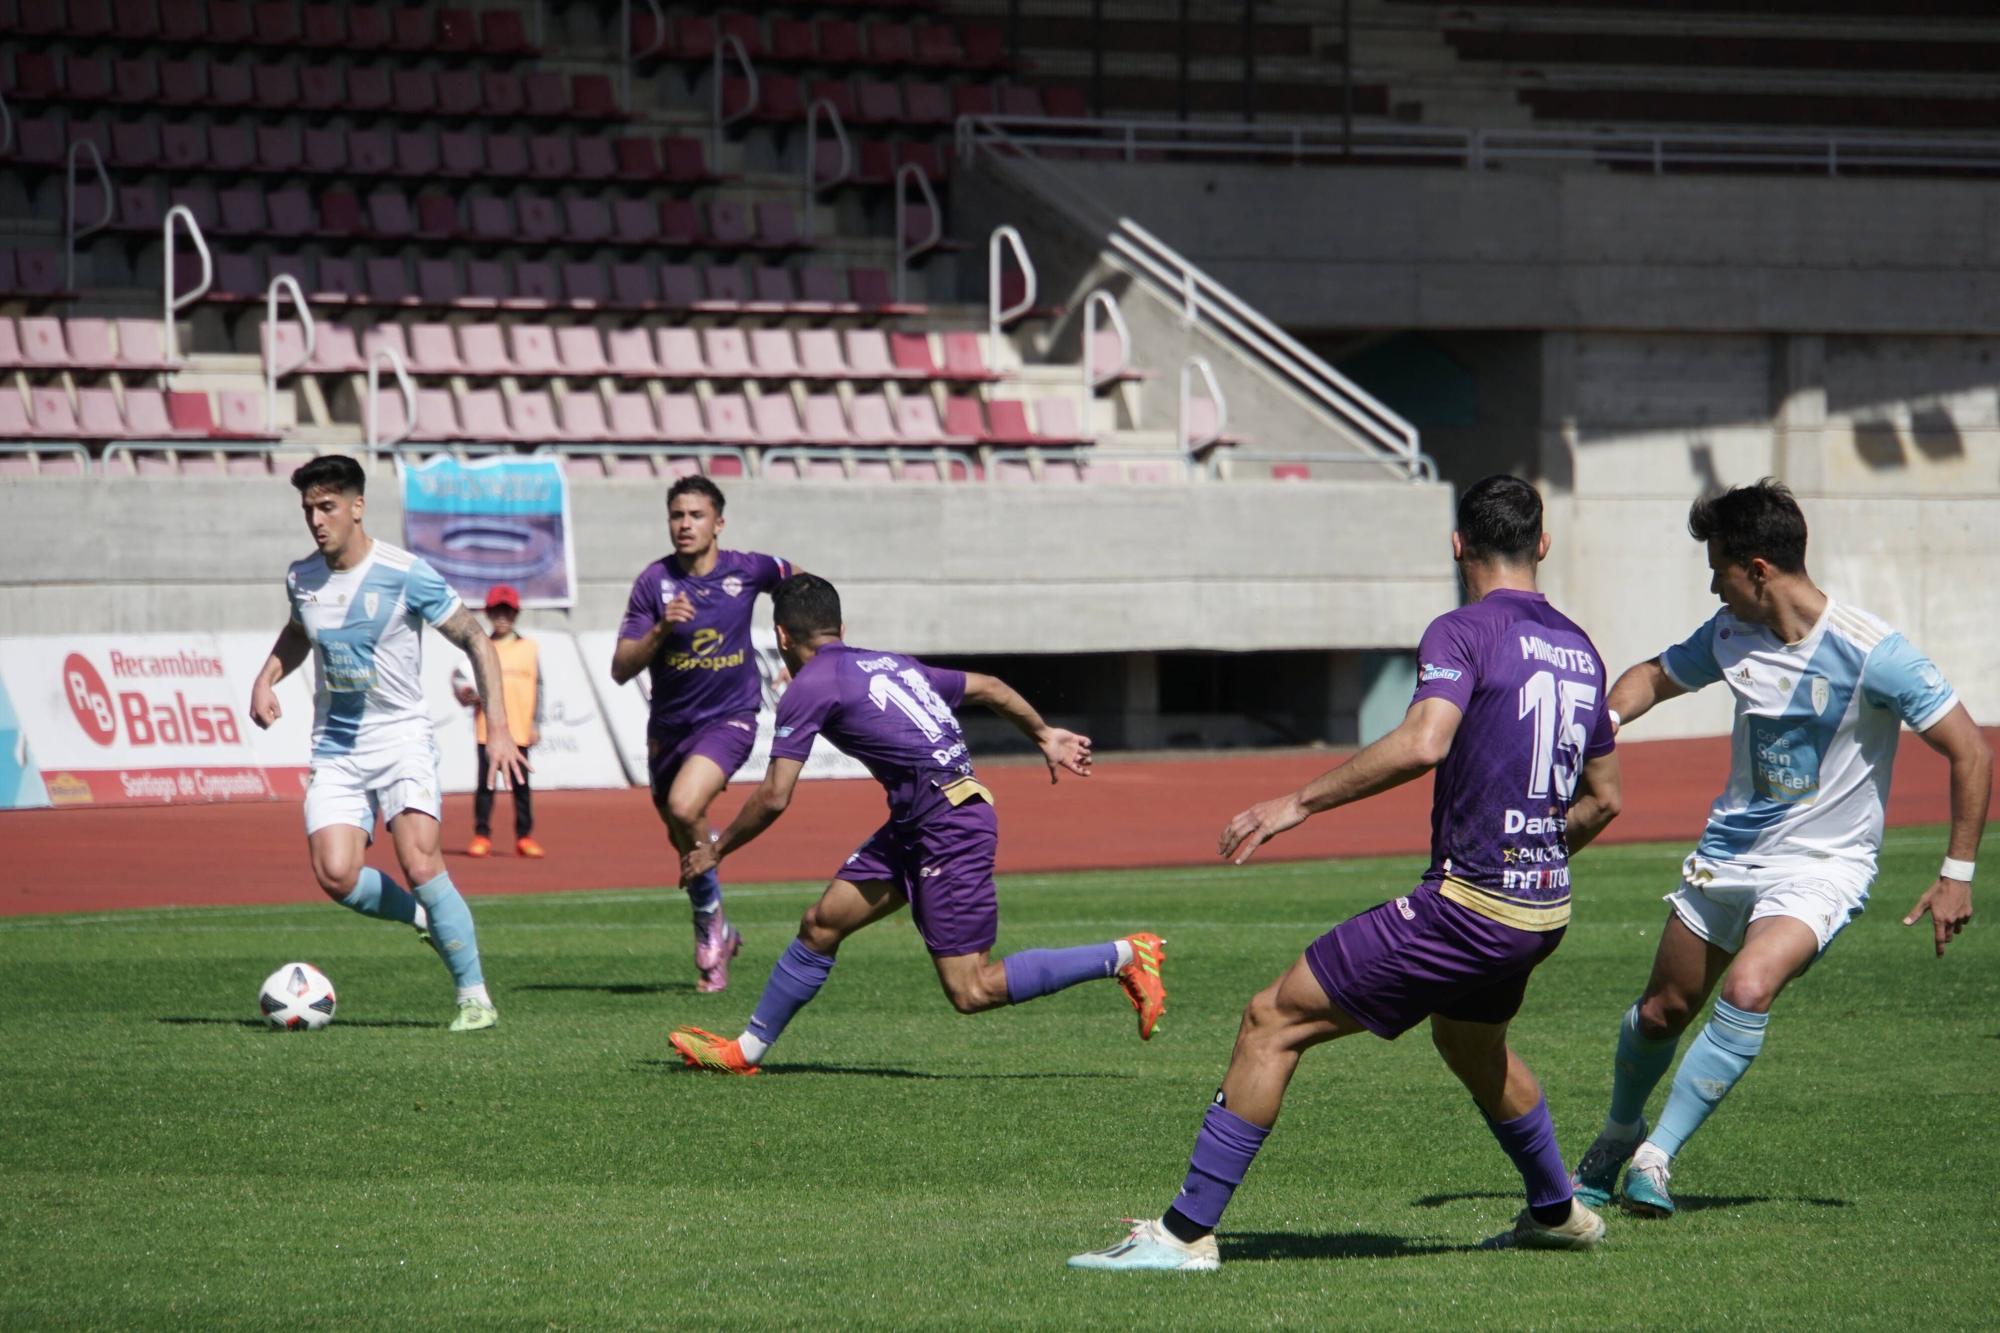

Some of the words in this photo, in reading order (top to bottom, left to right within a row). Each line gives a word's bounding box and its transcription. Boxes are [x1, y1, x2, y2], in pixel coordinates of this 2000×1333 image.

[109, 649, 224, 678] Recambios
[1519, 636, 1596, 676] MINGOTES
[118, 689, 241, 746] Balsa
[1518, 670, 1597, 801] 15
[1757, 743, 1791, 766] San
[1758, 761, 1810, 789] Rafael
